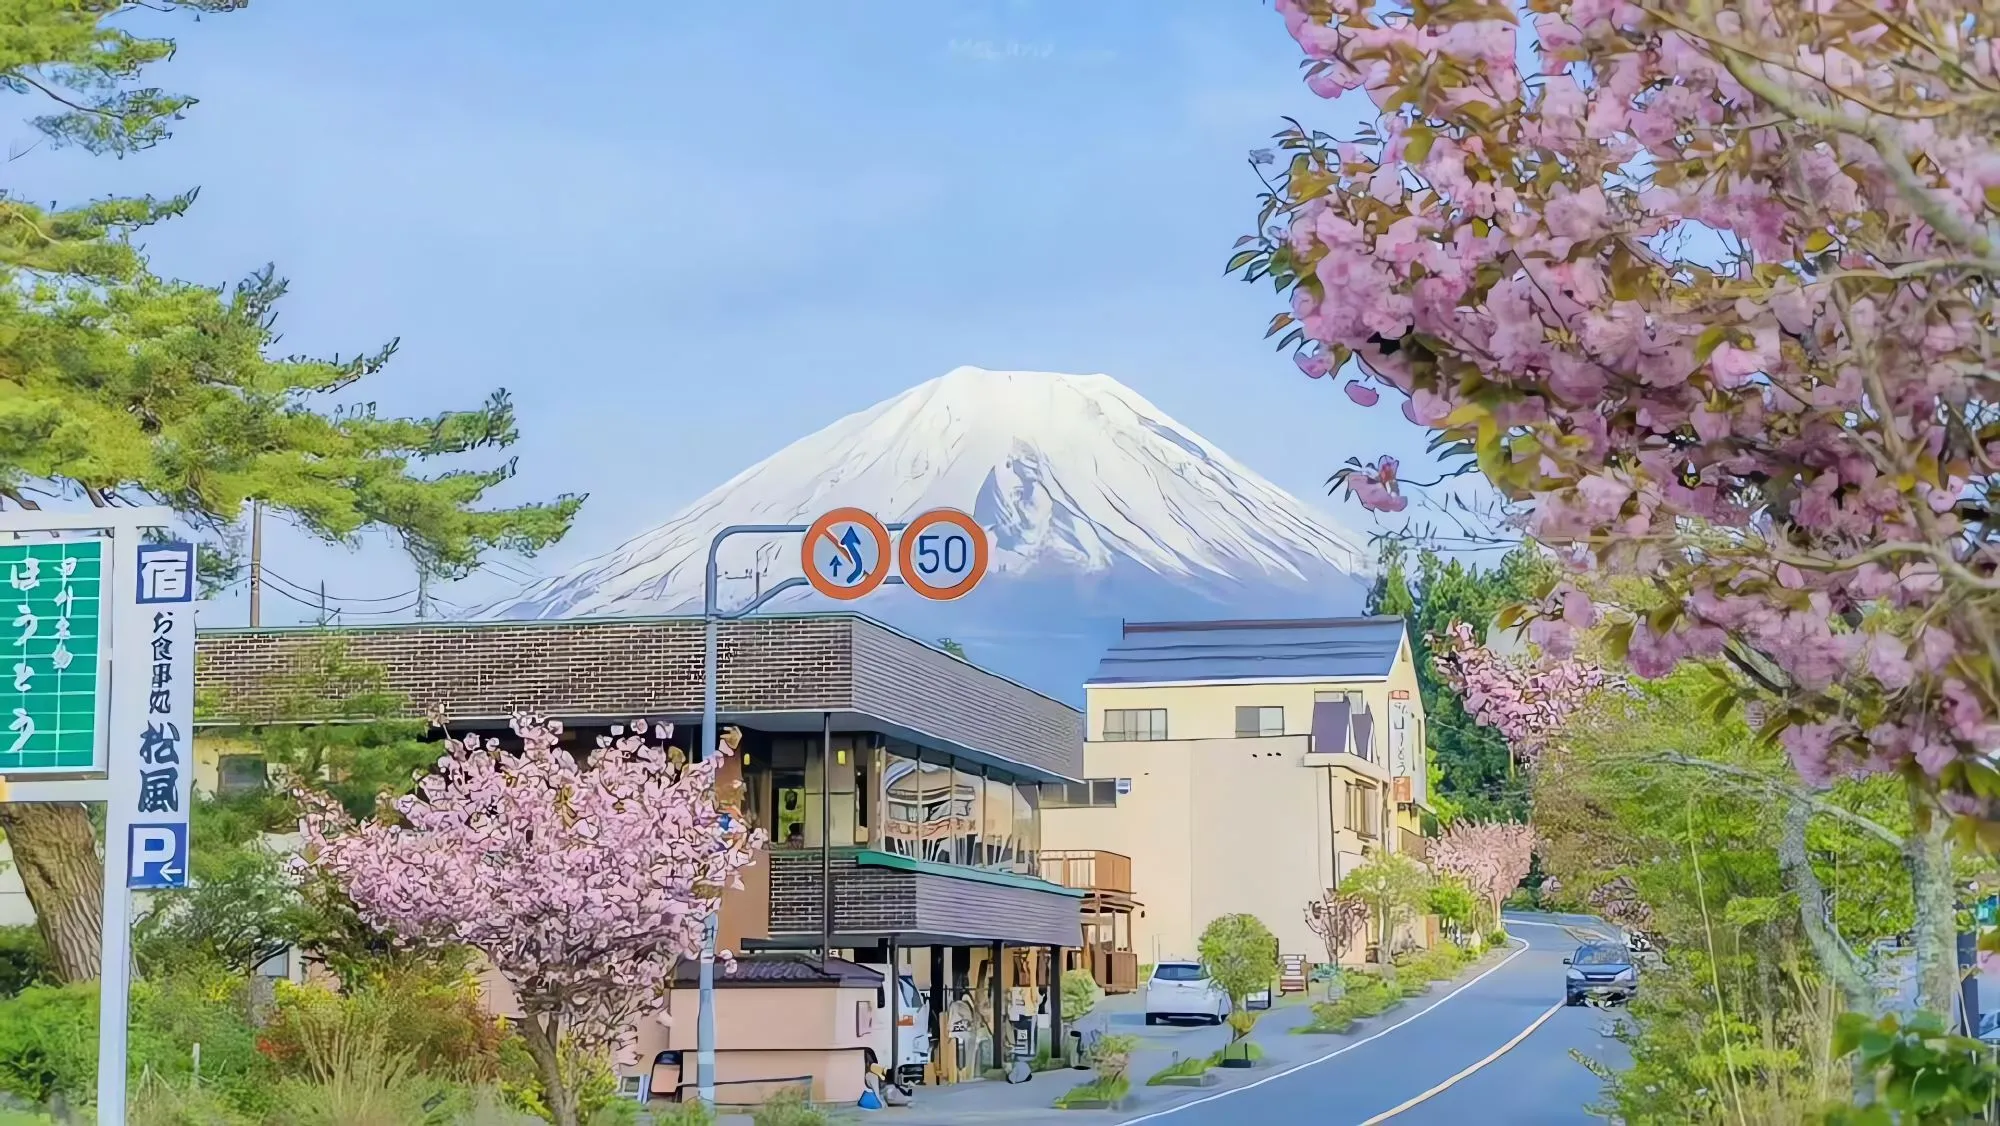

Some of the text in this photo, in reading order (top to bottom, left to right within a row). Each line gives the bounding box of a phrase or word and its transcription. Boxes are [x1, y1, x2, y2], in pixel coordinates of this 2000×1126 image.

[141, 550, 188, 599] 宿
[917, 535, 967, 574] 50
[8, 557, 40, 752] ほうとう
[137, 720, 180, 813] 松風
[131, 827, 177, 878] P
